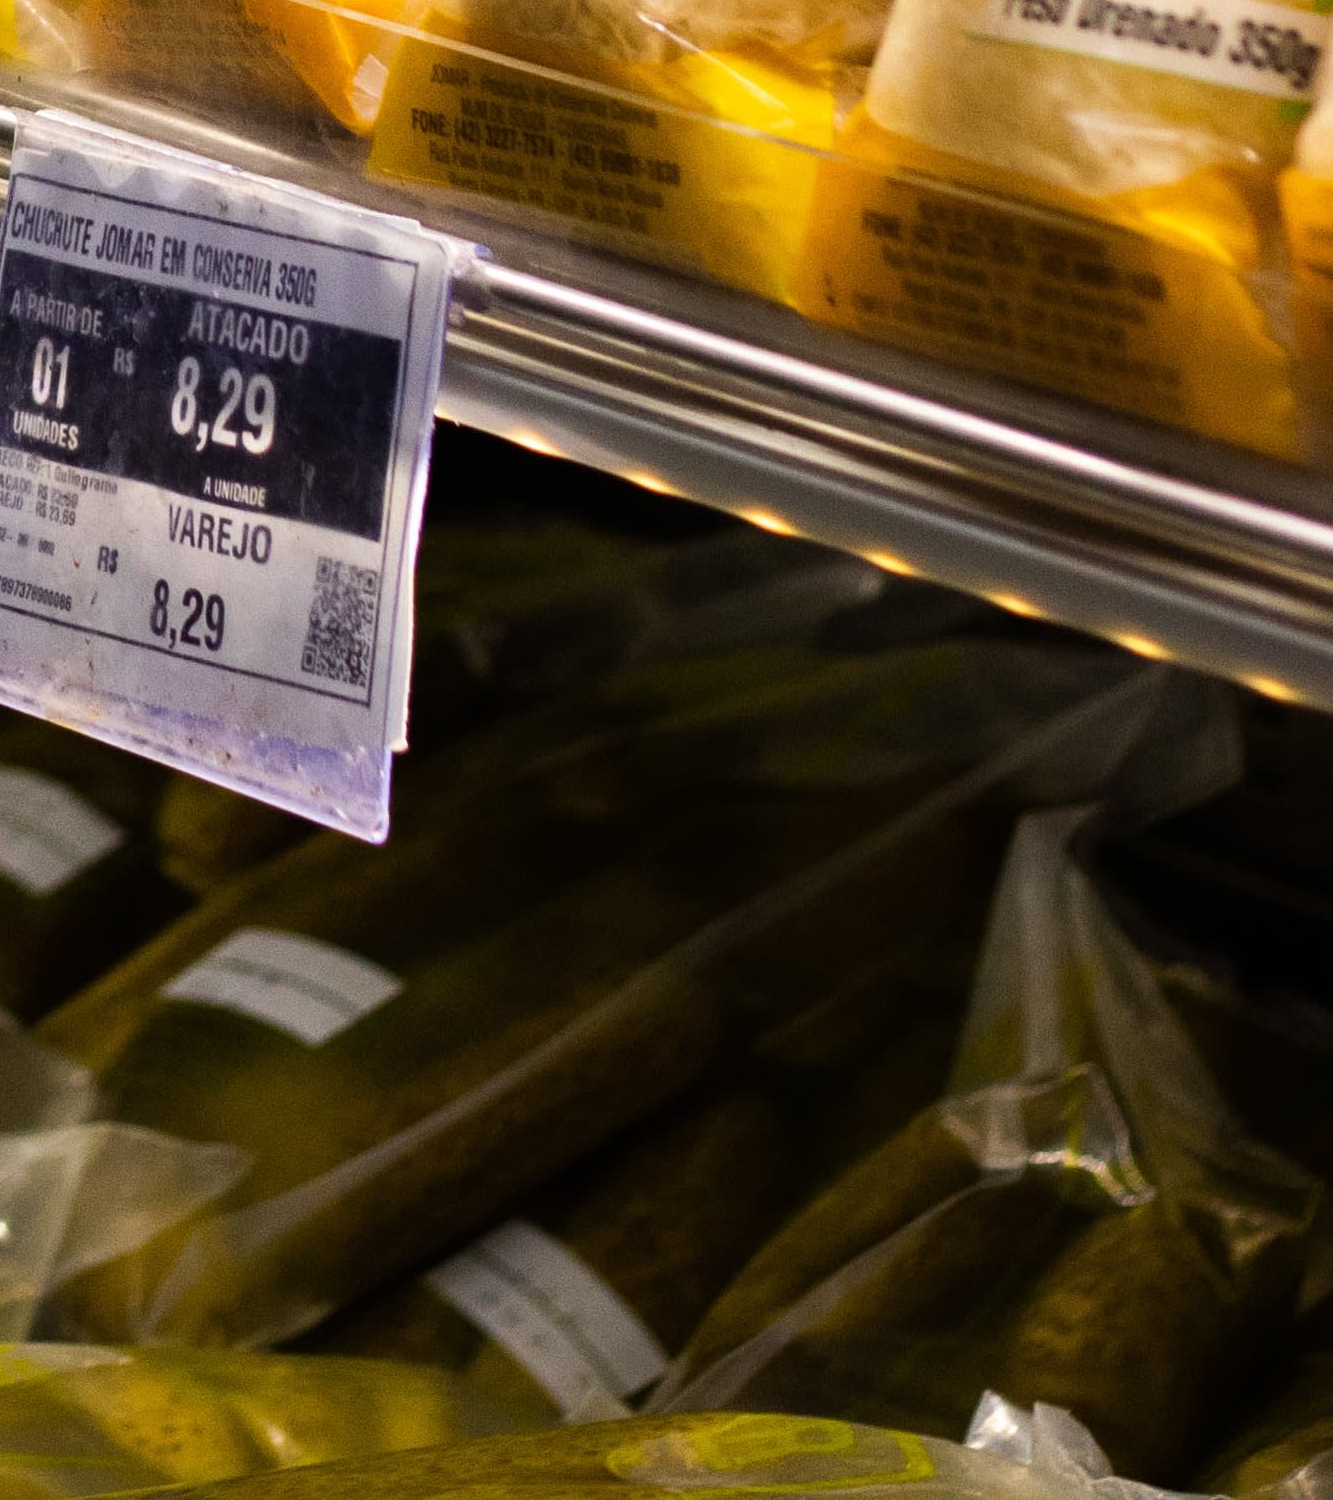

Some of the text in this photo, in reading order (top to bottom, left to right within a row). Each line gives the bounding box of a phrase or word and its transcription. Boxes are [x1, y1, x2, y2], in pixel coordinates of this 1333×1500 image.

[1229, 19, 1324, 92] 350g
[10, 199, 318, 309] CHUCRUTE JOMAR EM CONSERVA 350G
[9, 289, 104, 339] A PARTIR DE
[187, 300, 310, 366] ATACADO
[31, 337, 277, 456] 01 R$ 8,29
[13, 409, 80, 452] UNIDADES
[48, 503, 77, 527] 23.69
[204, 476, 267, 508] A UNIDADE
[96, 544, 120, 575] R$
[168, 502, 273, 565] VAREJO
[150, 578, 226, 653] 8,29
